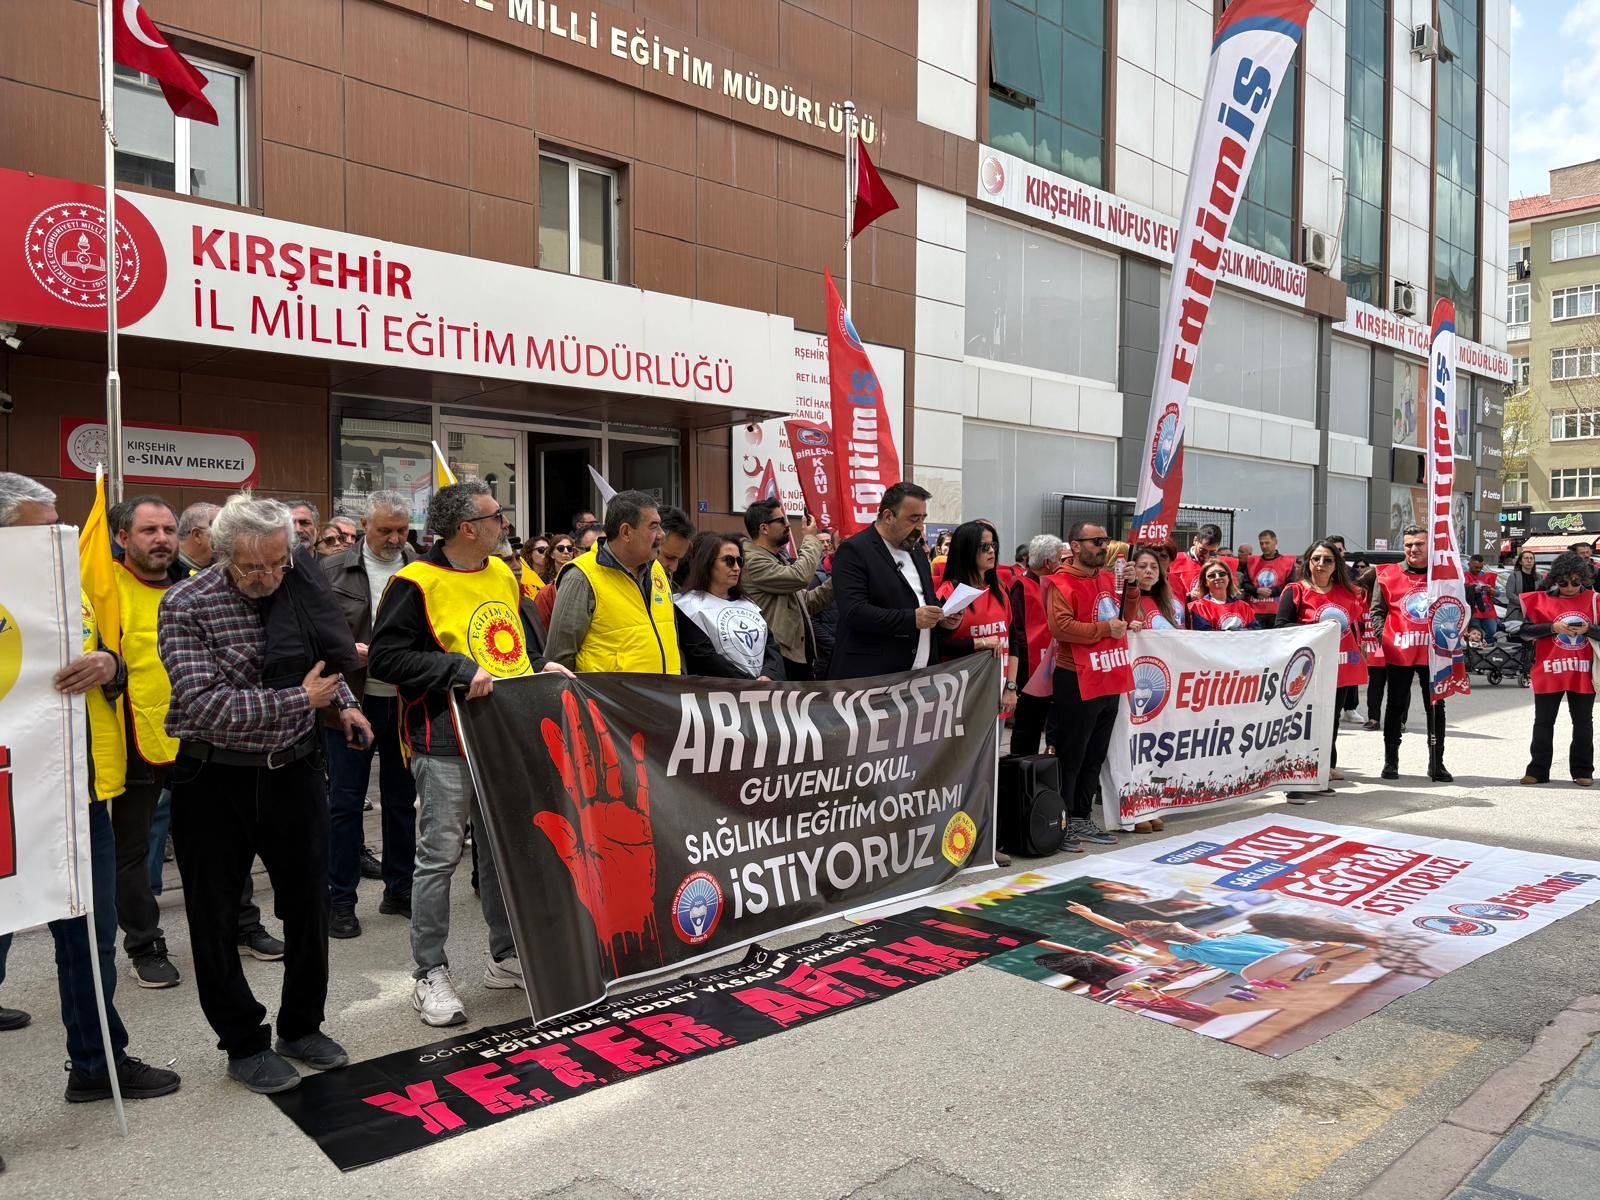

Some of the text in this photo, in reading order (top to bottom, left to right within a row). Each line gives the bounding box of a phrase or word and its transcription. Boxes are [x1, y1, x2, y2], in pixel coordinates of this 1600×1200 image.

[610, 27, 713, 90] EĞİTİM
[192, 225, 413, 300] KIRŞEHİR
[1025, 175, 1091, 225] KIRŞEHİR
[1093, 193, 1105, 230] İL
[1108, 203, 1151, 244] NÜFUS
[1152, 221, 1169, 250] VE
[1244, 261, 1306, 299] MÜDÜRLÜĞÜ
[194, 279, 734, 394] İL MİLLÎ EĞİTİM MÜDÜRLÜĞÜ
[1355, 310, 1509, 377] KIRŞEHİR TİCA MÜDÜRLÜĞÜ
[127, 440, 176, 453] KIRŞEHİR
[127, 453, 245, 471] e-SINAV MERKEZİ
[811, 457, 828, 495] KAMU
[471, 607, 502, 640] EĞİTİM
[970, 620, 1008, 637] EMEK
[666, 669, 970, 777] ARTIK YETER!
[1238, 704, 1313, 759] ŞUBESİ
[740, 755, 917, 805] GÜVENLİ OKUL,
[685, 784, 963, 865] SAĞLIKLI EĞİTİM ORTAMI
[1207, 831, 1326, 869] OKUL
[730, 824, 936, 919] İSTİYORUZ
[1228, 862, 1288, 888] SAĞLIKLI
[419, 1012, 581, 1064] ÖĞRETMENLERİ
[584, 977, 699, 1015] KORURSANIZ
[479, 1017, 607, 1060] EĞİTİMDE
[610, 990, 698, 1022] ŞİDDET
[362, 1012, 739, 1136] YETER
